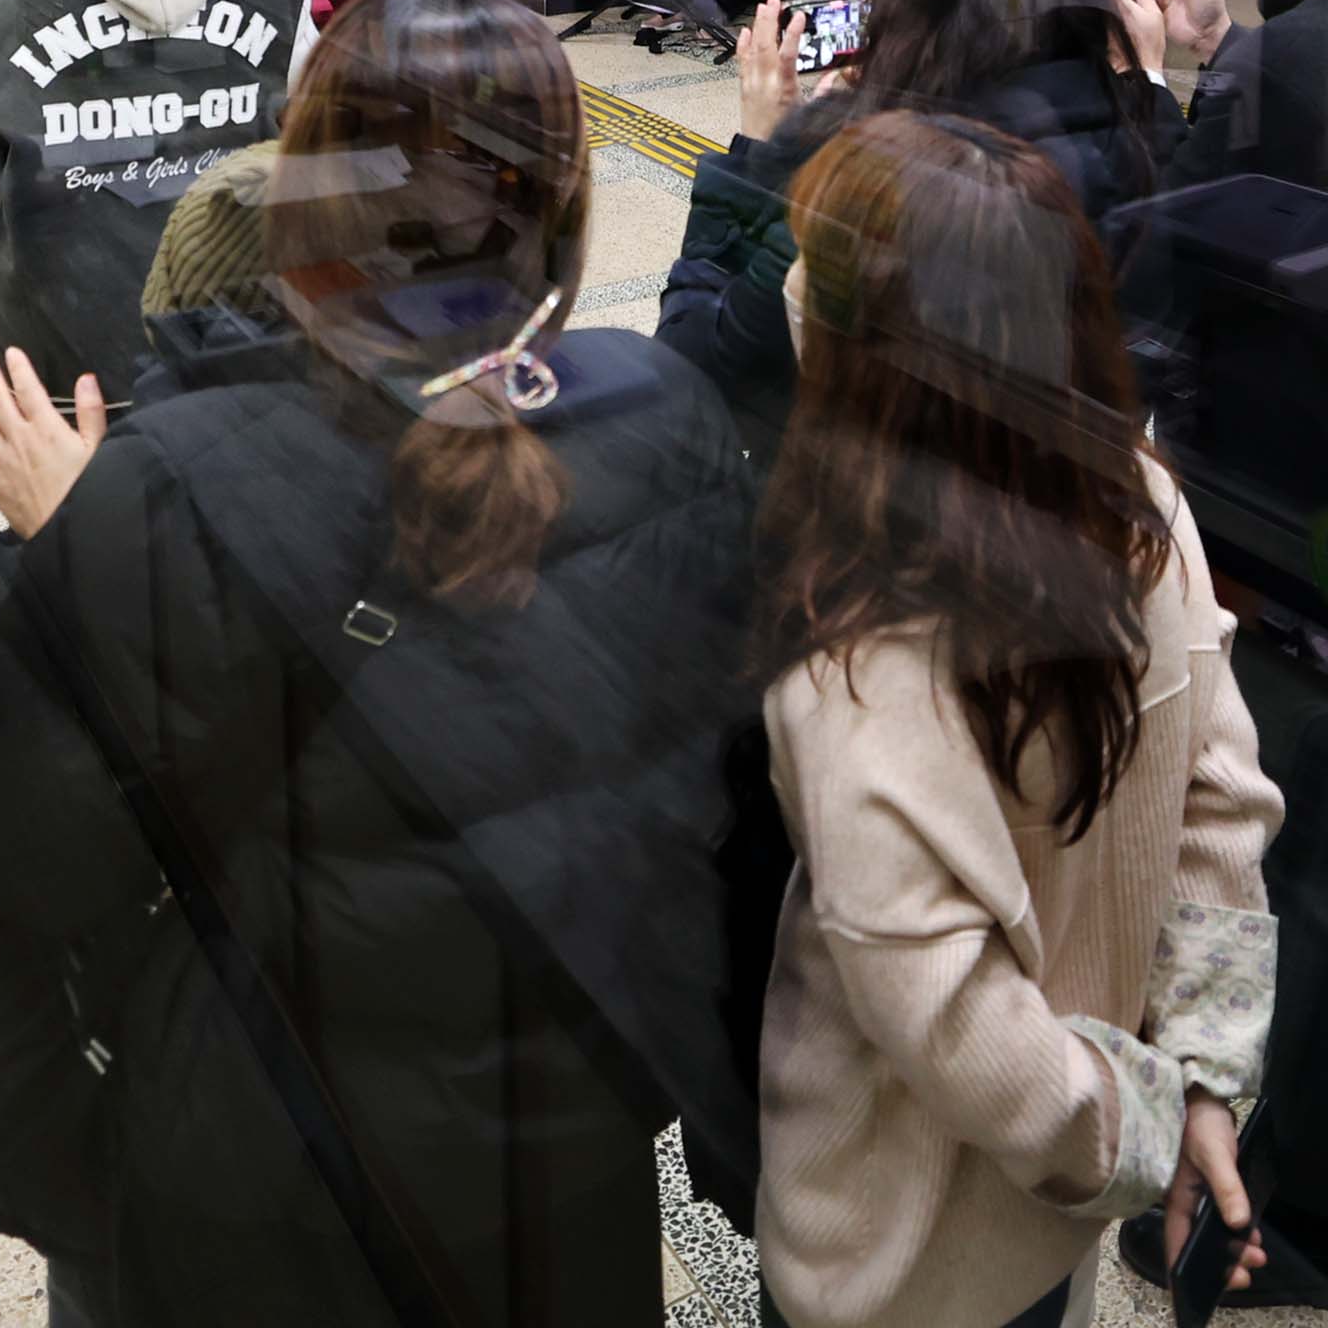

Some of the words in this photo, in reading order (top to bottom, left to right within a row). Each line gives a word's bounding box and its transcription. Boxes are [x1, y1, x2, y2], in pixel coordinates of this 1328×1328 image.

[9, 0, 279, 89] INCON
[42, 82, 260, 147] DONG-GU
[65, 165, 115, 191] Boys
[121, 160, 139, 180] &
[145, 153, 189, 190] Girls
